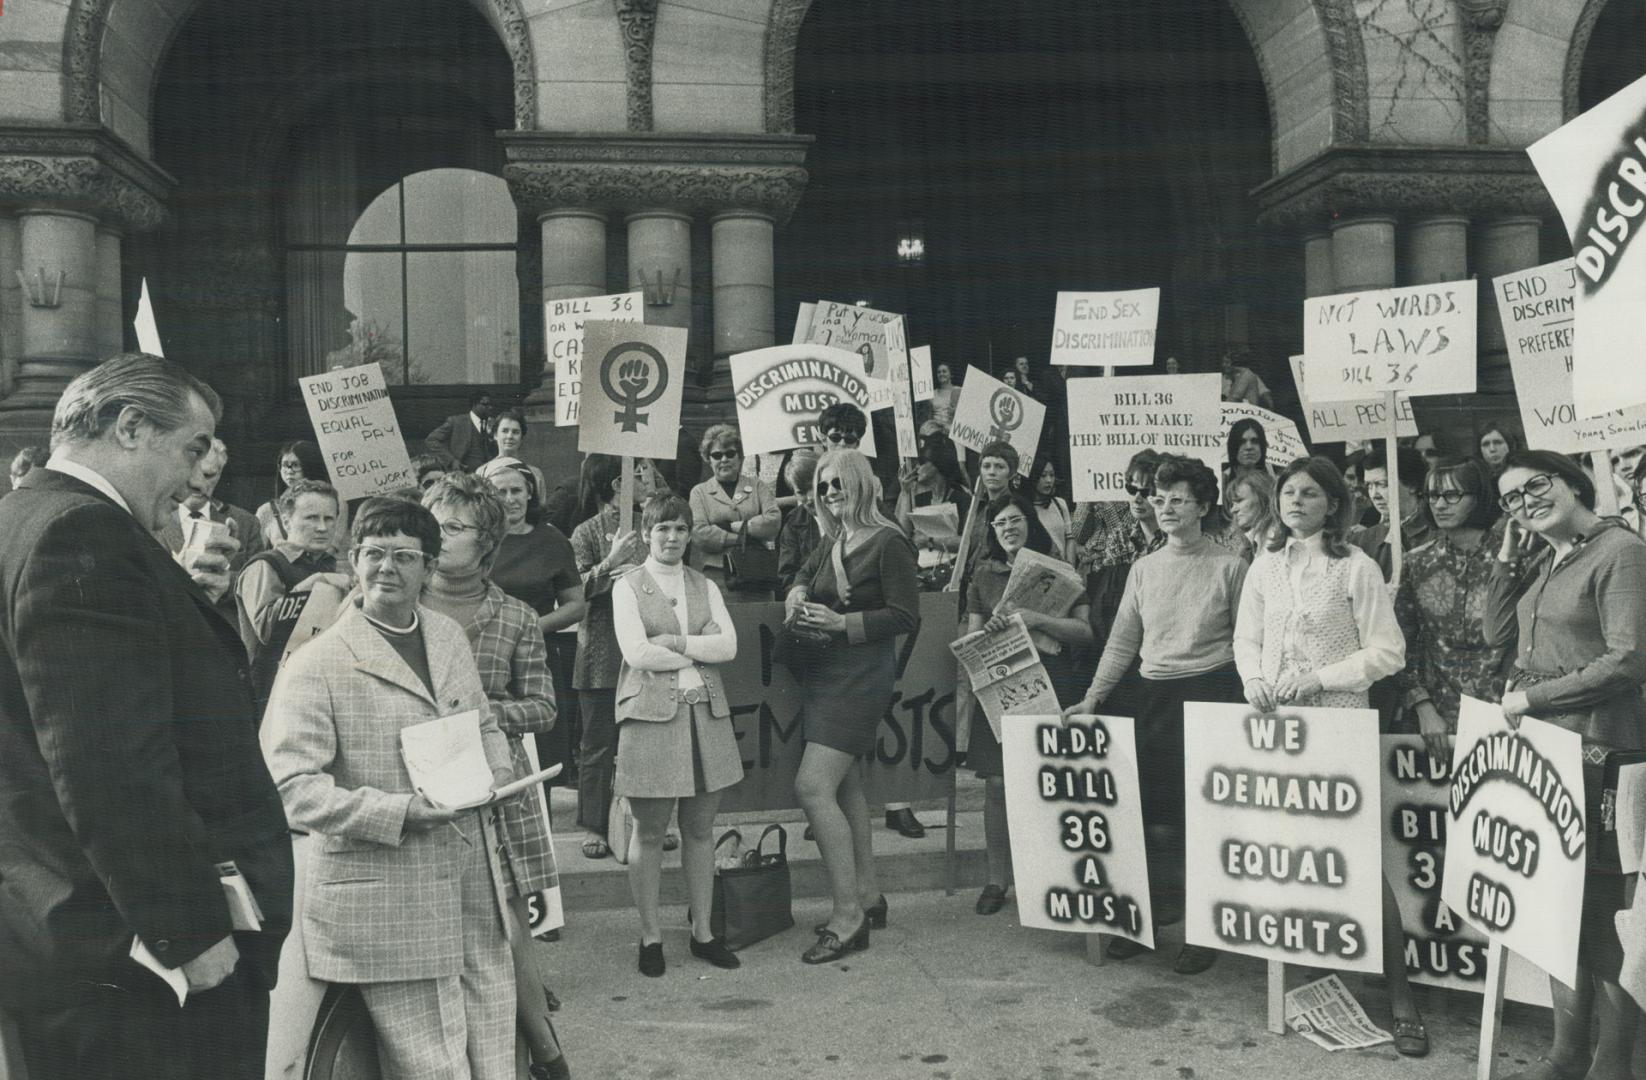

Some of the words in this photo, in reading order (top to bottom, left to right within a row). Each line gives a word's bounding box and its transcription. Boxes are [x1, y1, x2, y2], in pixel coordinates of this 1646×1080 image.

[1503, 276, 1547, 302] END
[555, 301, 592, 316] BILL
[611, 297, 632, 312] 36
[827, 303, 849, 318] Put
[1073, 299, 1107, 320] END
[1112, 299, 1141, 319] SEX
[1319, 297, 1360, 325] NOT
[822, 317, 833, 325] in
[1349, 327, 1450, 355] LAWS
[1519, 328, 1574, 354] PREFERE
[309, 382, 333, 395] END
[341, 373, 369, 390] JOB
[737, 361, 869, 407] DISCRIMINATION
[1343, 365, 1372, 384] BILL
[1387, 364, 1419, 383] 36
[1114, 393, 1151, 406] BILL
[1155, 393, 1173, 405] 36
[321, 416, 373, 434] EQUAL
[1100, 414, 1139, 426] WILL
[1145, 414, 1193, 426] MAKE
[1312, 410, 1347, 428] ALL
[1356, 400, 1415, 424] PEOLE
[361, 426, 395, 441] PAY
[1070, 434, 1101, 446] THE
[1107, 433, 1139, 446] BILL
[1141, 433, 1159, 446] OF
[1164, 434, 1221, 447] RIGHTS
[1574, 430, 1605, 440] Young
[332, 450, 354, 462] FOR
[1249, 718, 1300, 750] WE
[1041, 770, 1115, 800] BILL
[1211, 771, 1357, 812] DEMAND
[1451, 736, 1586, 856] DISCRIMINATION
[1063, 815, 1107, 848] 36
[1474, 815, 1537, 875] MUST
[1083, 858, 1100, 885] A
[1228, 844, 1343, 884] EQUAL
[1050, 893, 1139, 931] MUST
[1434, 900, 1454, 931] A
[1471, 878, 1511, 927] END
[1220, 907, 1359, 955] RIGHTS
[1404, 938, 1488, 976] MUS
